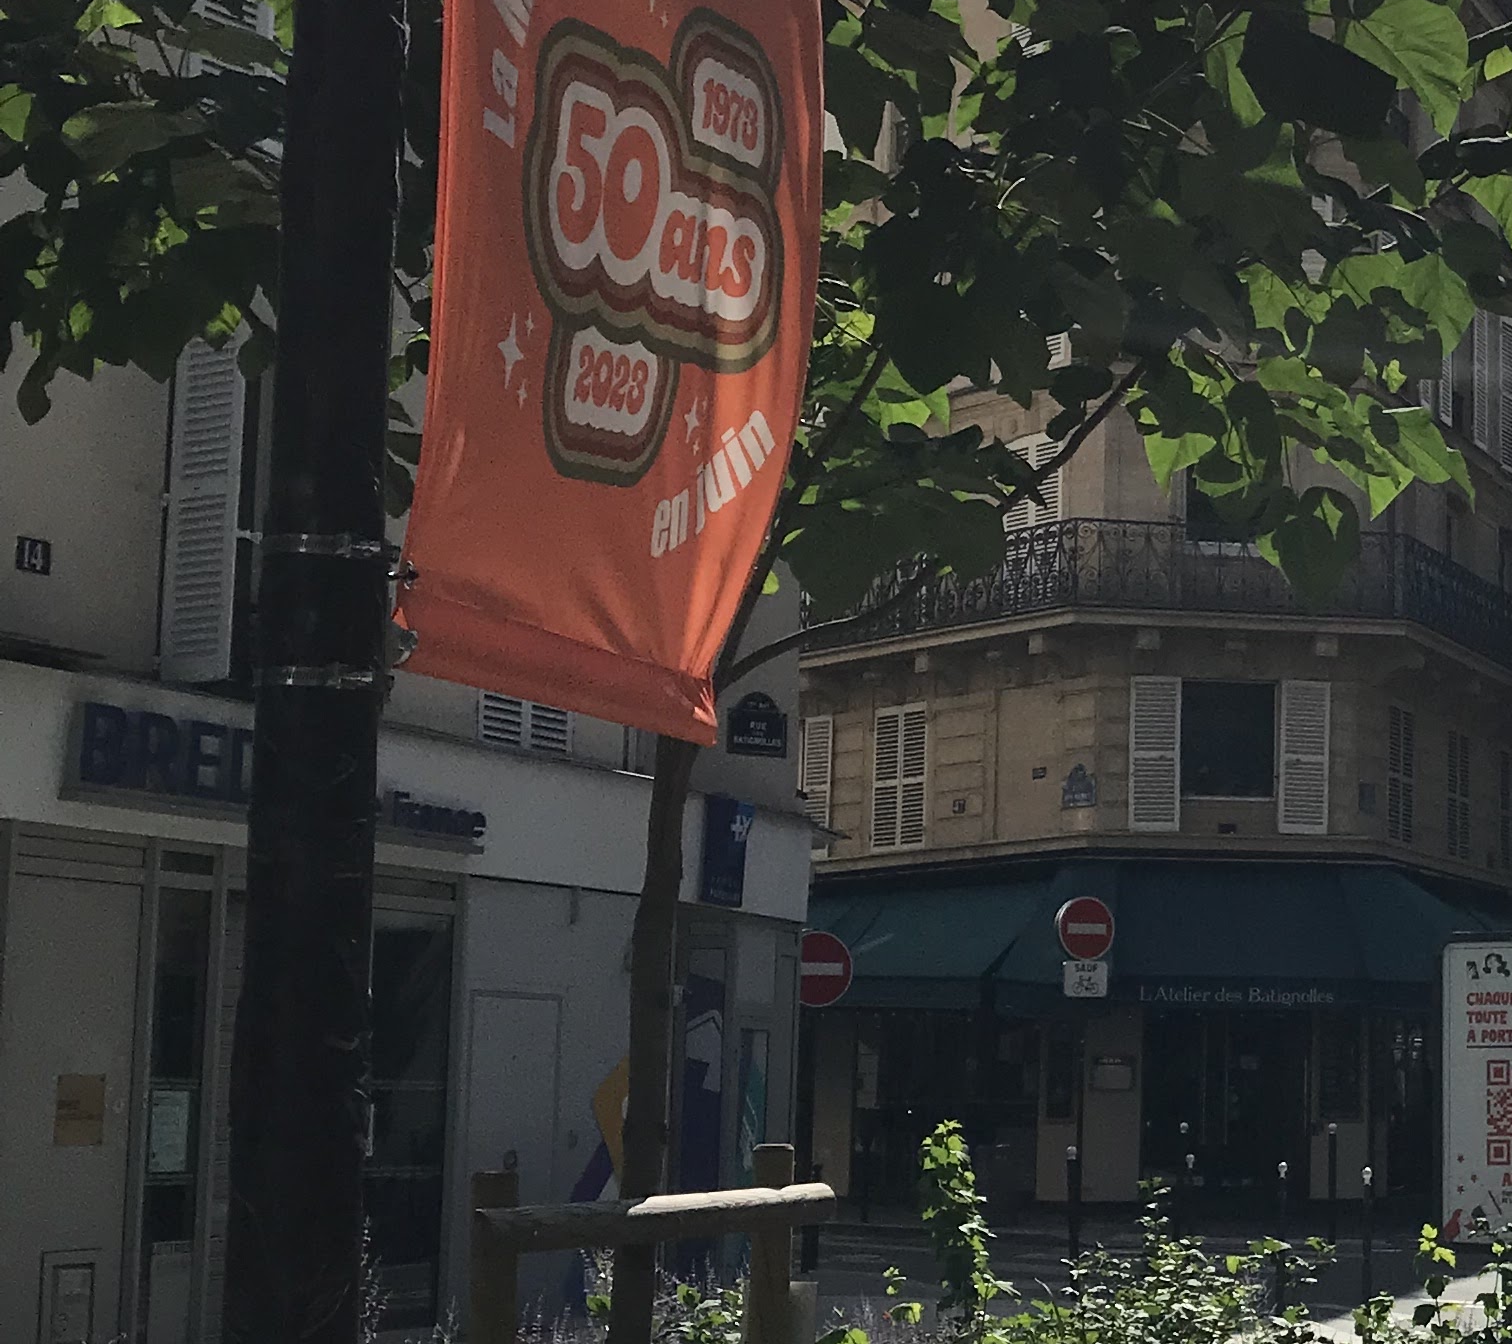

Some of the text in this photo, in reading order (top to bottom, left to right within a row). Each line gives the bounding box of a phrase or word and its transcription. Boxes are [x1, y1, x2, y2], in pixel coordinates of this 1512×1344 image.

[483, 52, 520, 149] La
[701, 76, 760, 152] 1973
[556, 100, 757, 299] 50 ans
[573, 344, 650, 416] 2023
[649, 407, 777, 559] en juin
[23, 540, 43, 571] 14
[749, 720, 768, 731] RUE
[1074, 963, 1098, 973] SAUF
[1214, 986, 1242, 1003] des
[1248, 986, 1335, 1007] Batignolles
[1466, 1010, 1508, 1024] TOUTE
